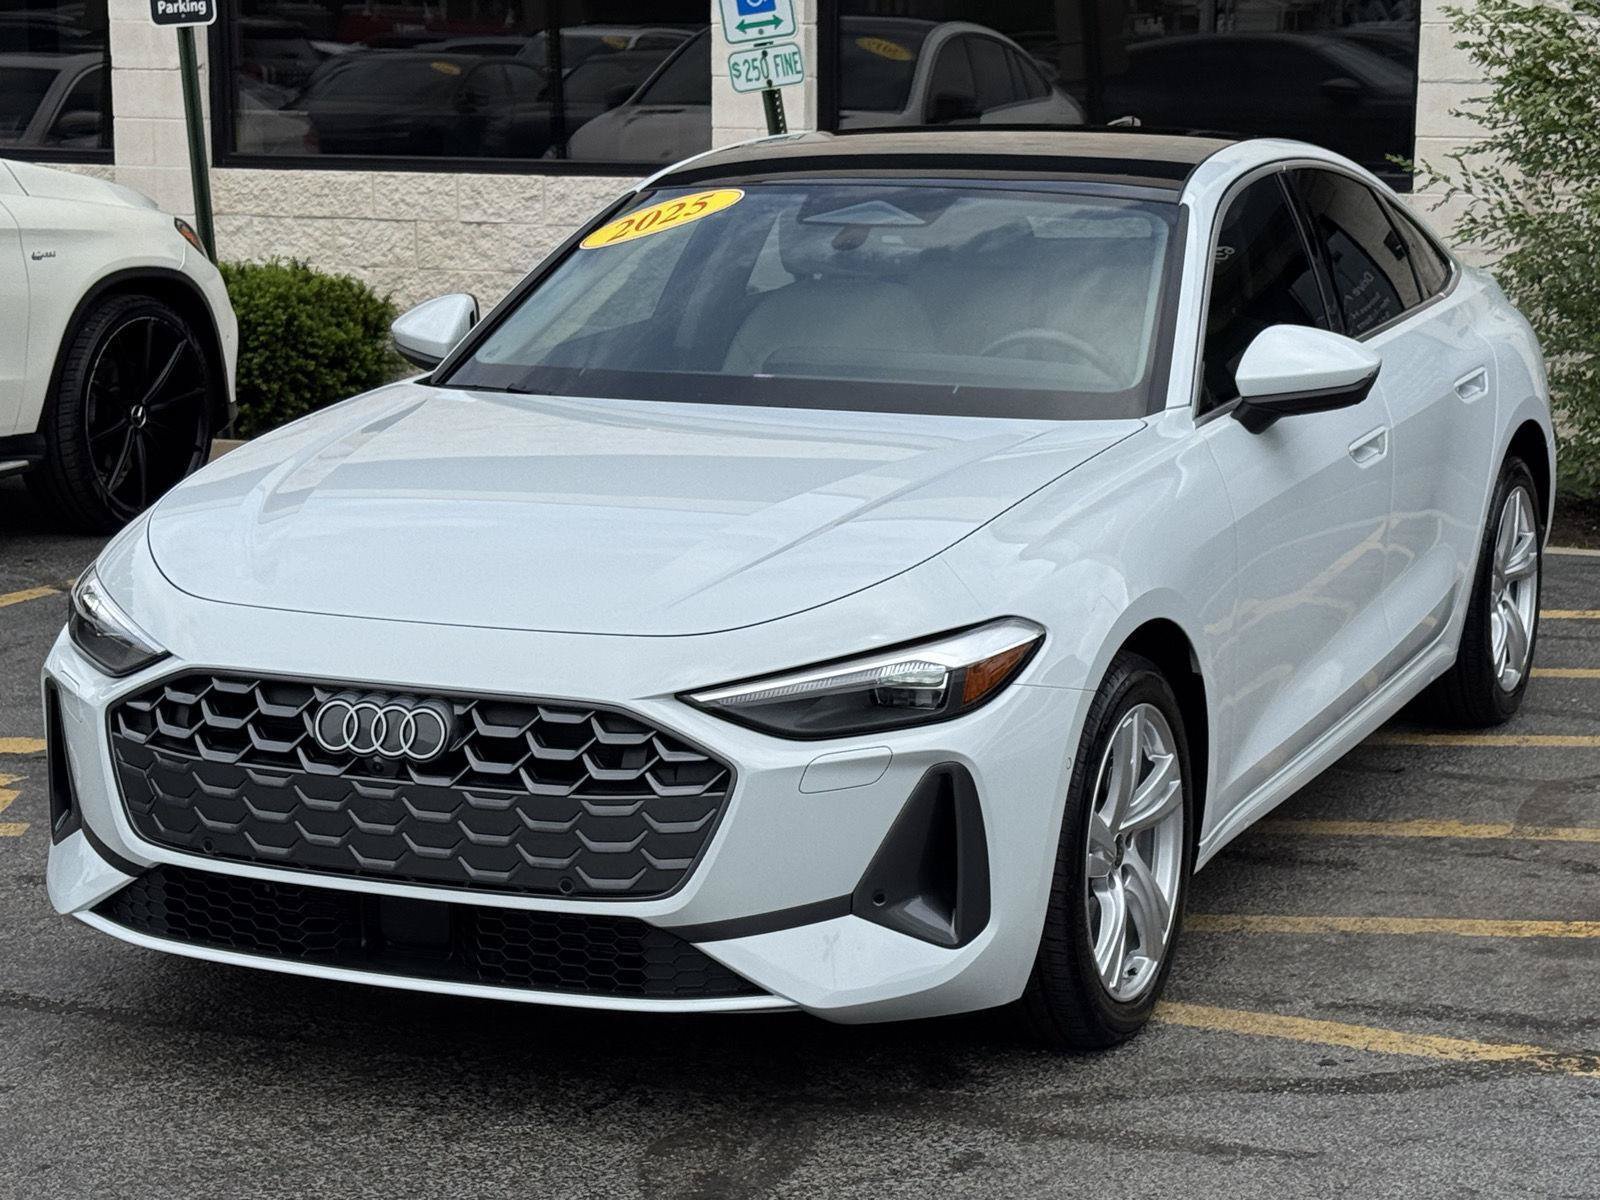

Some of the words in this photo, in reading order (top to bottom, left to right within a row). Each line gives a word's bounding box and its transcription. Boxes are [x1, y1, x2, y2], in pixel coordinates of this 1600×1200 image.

[157, 0, 207, 15] Parking
[731, 56, 770, 82] $250
[773, 51, 802, 78] FINE
[606, 193, 716, 243] 2025
